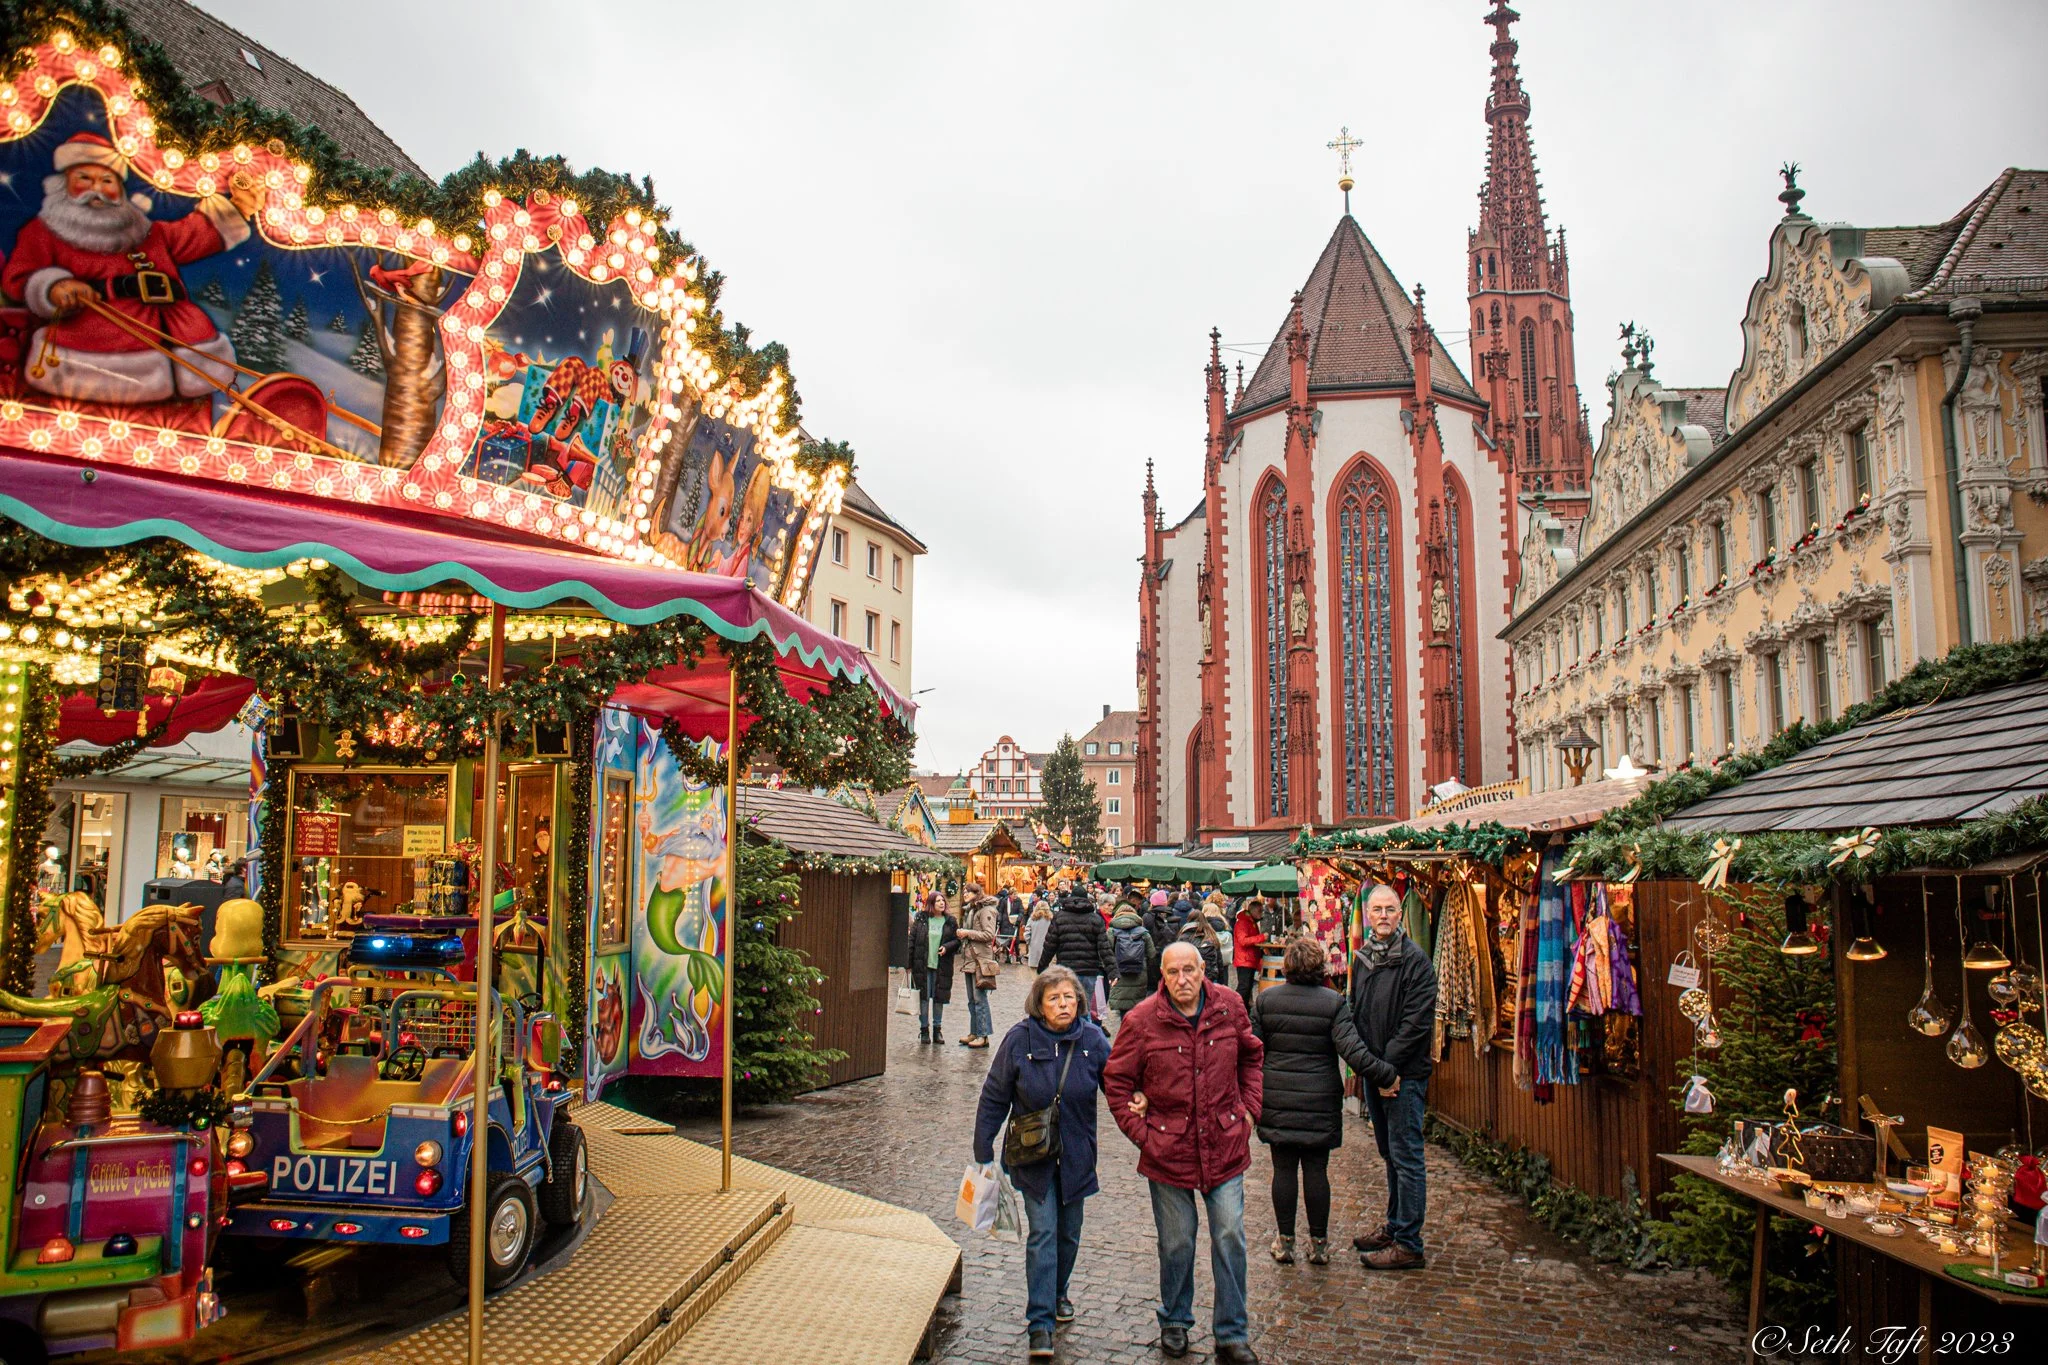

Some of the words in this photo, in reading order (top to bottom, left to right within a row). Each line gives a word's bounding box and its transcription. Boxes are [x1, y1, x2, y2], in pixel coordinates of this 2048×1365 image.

[90, 1162, 130, 1194] Little
[134, 1160, 171, 1197] Train
[271, 1155, 397, 1195] POLIZEI
